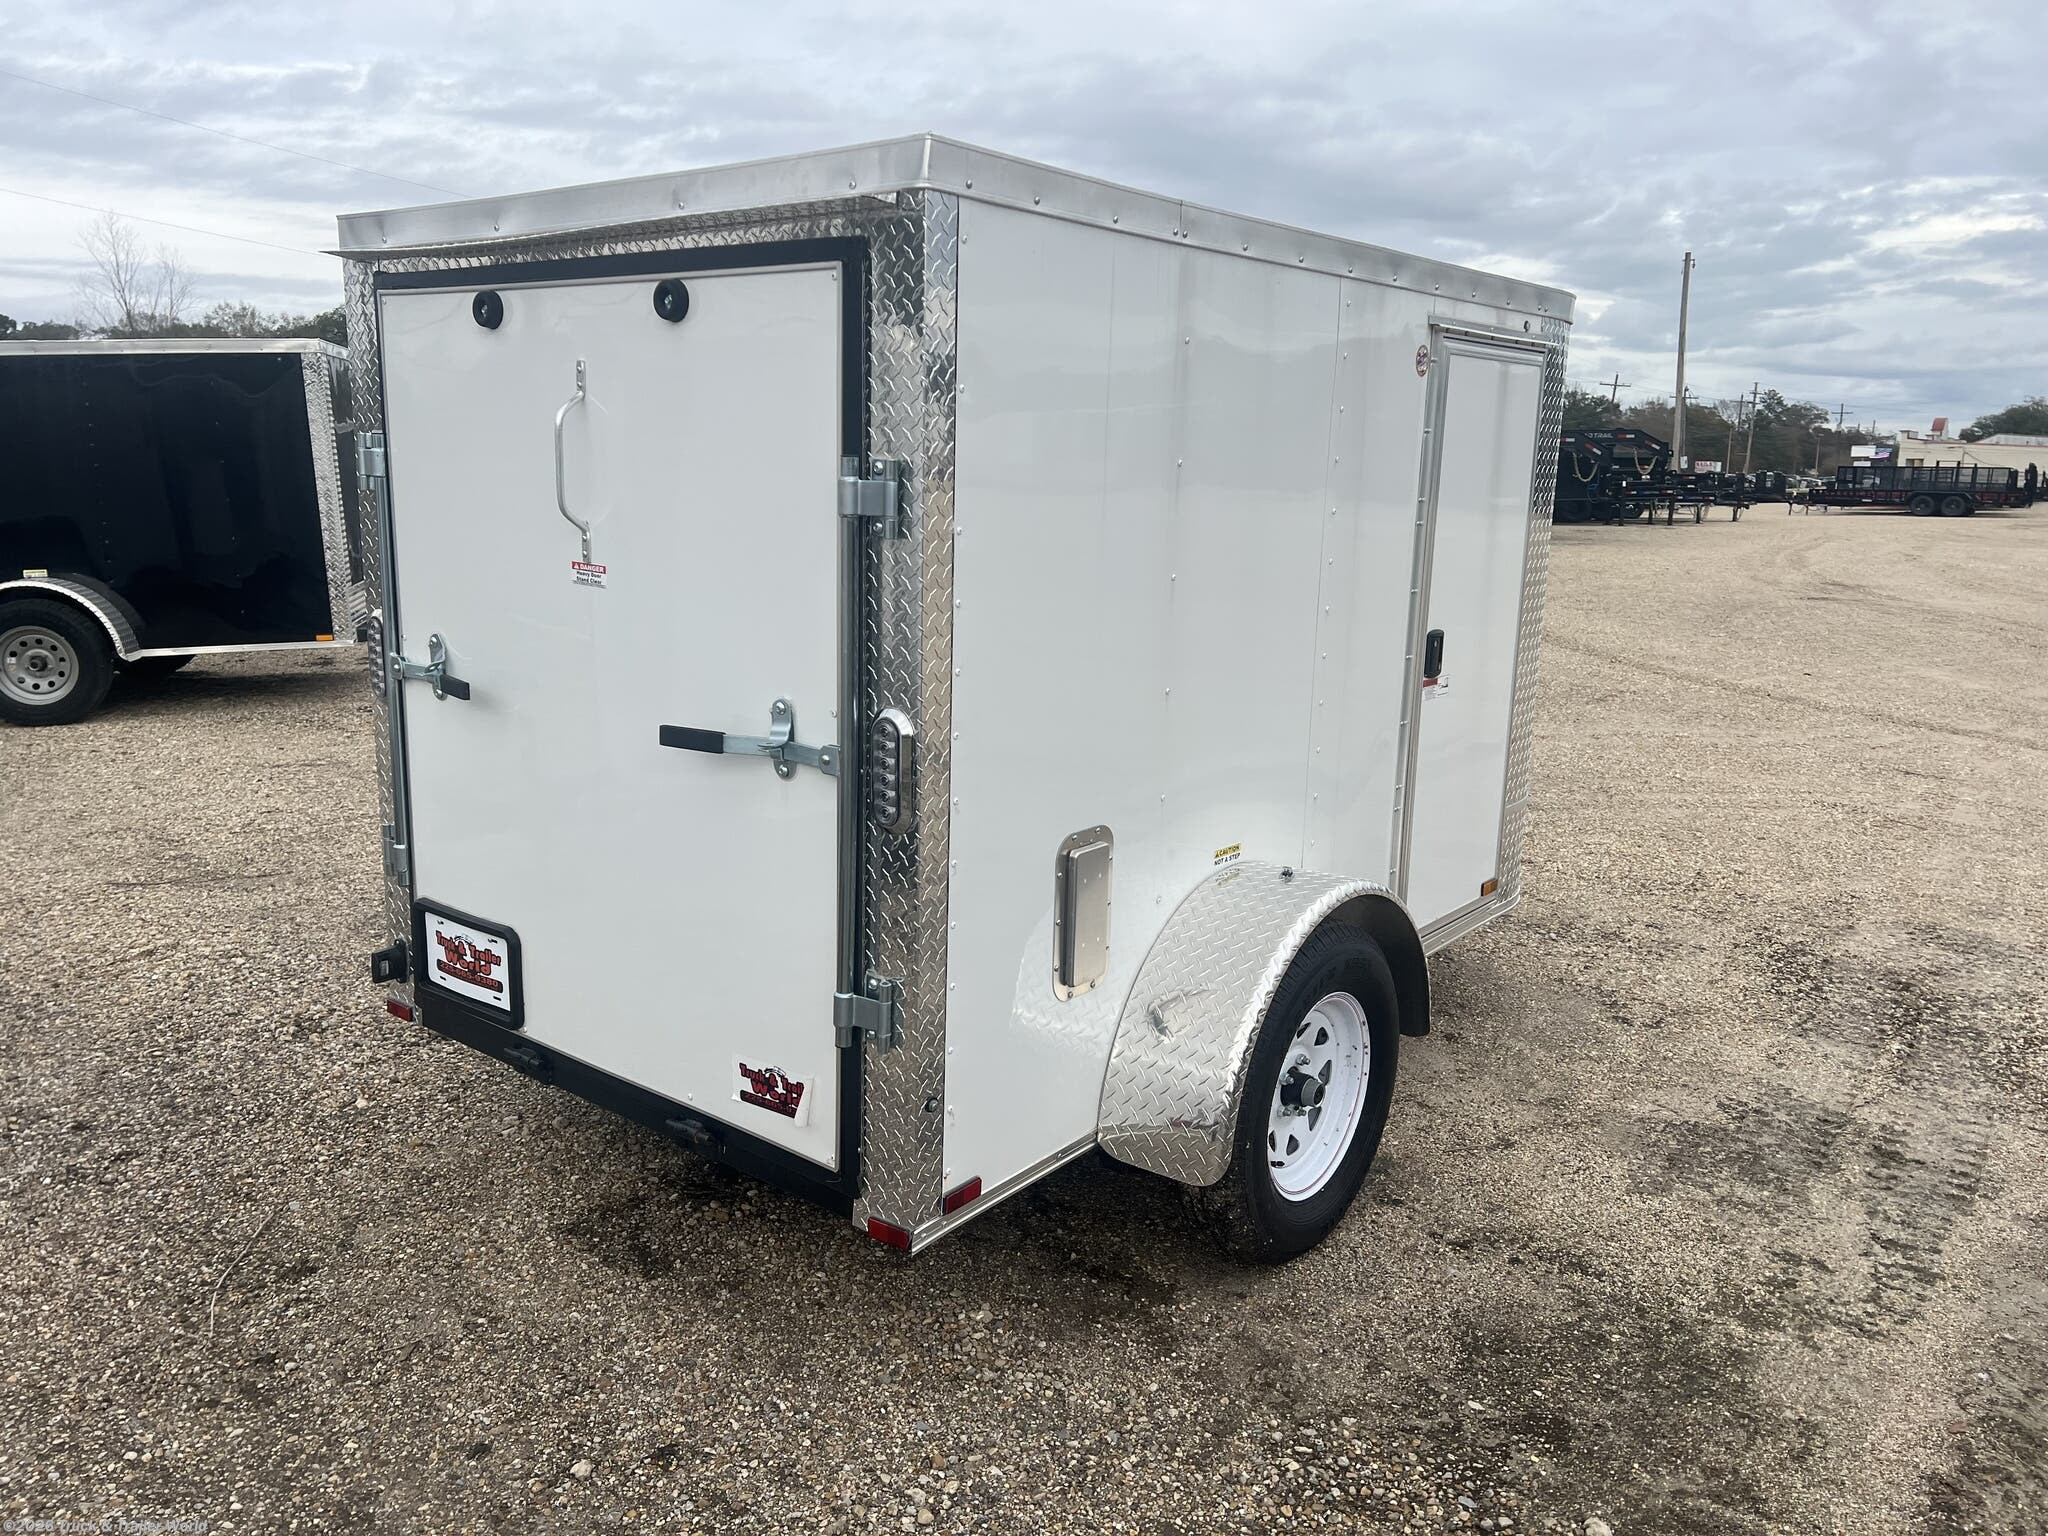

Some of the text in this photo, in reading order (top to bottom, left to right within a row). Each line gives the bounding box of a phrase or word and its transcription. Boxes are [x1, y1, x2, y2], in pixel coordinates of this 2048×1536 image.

[579, 563, 604, 573] DANGER
[1214, 857, 1225, 866] NOT
[1229, 852, 1241, 862] STEP
[1219, 844, 1240, 857] CAUTION
[436, 930, 456, 951] Truck
[469, 945, 502, 967] Trailer
[444, 950, 492, 976] World
[739, 1062, 765, 1083] Truck
